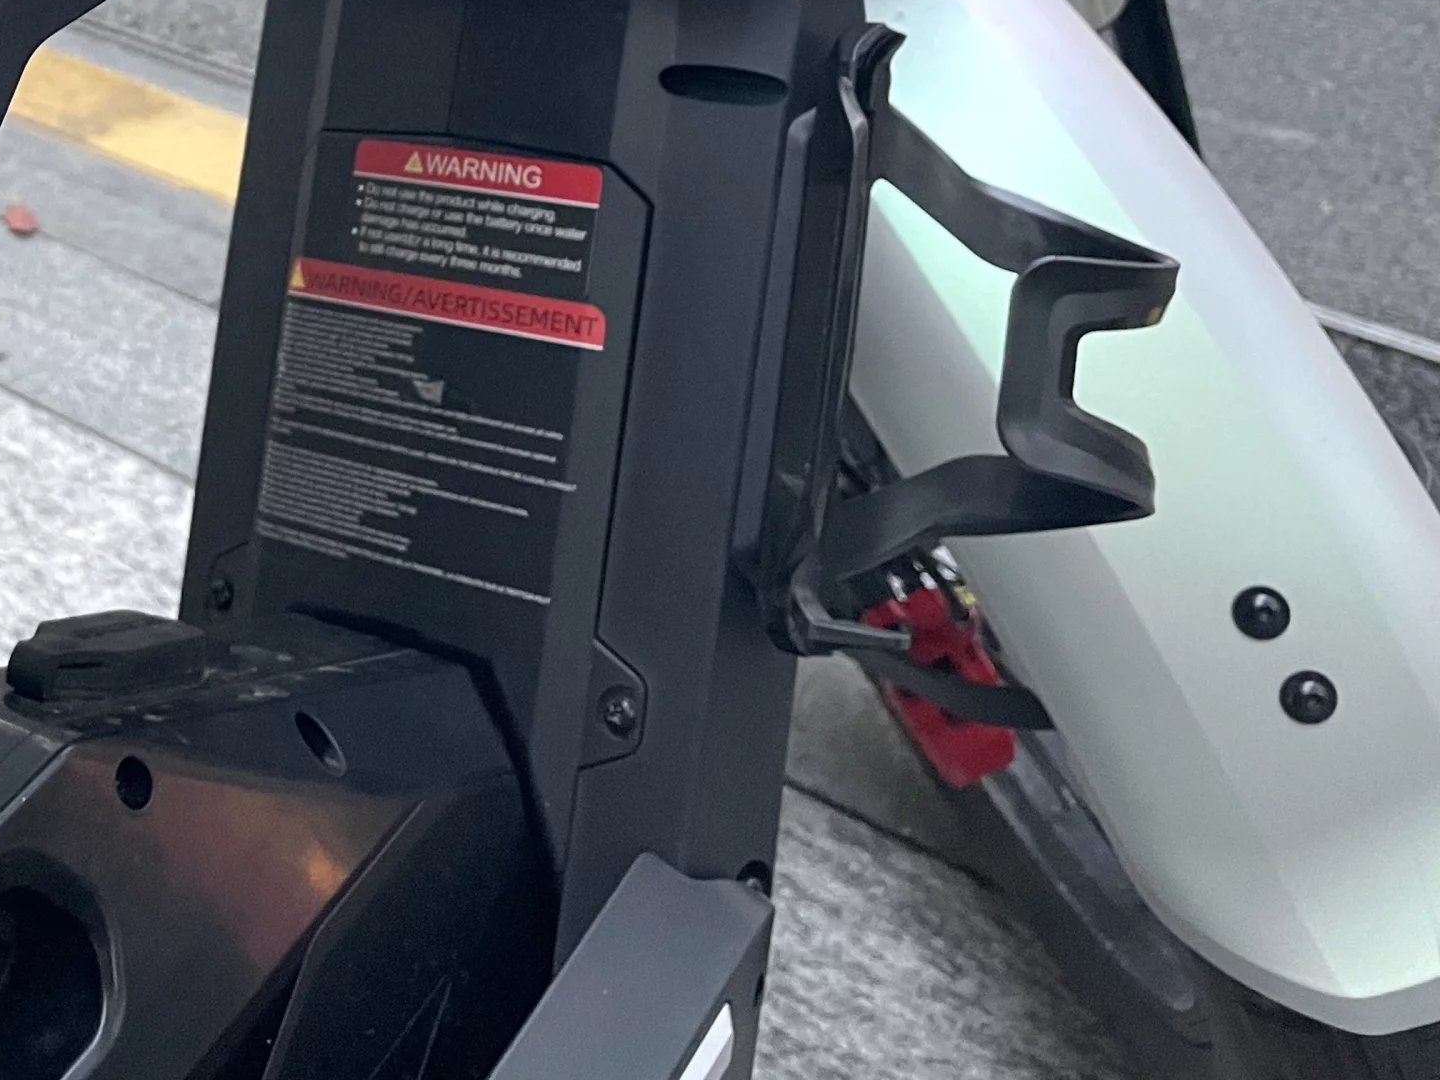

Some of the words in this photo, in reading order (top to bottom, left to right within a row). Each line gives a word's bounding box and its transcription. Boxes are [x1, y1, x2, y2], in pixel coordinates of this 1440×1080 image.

[426, 151, 543, 189] WARNING
[366, 182, 380, 196] Do
[381, 186, 398, 198] not
[398, 190, 417, 202] use
[418, 191, 434, 203] the
[435, 194, 476, 210] product
[477, 199, 505, 213] while
[361, 212, 400, 229] damage
[401, 217, 419, 231] has
[364, 196, 378, 209] Do
[380, 200, 396, 211] not
[397, 203, 430, 218] charge
[431, 209, 443, 219] or
[444, 211, 465, 223] use
[465, 211, 484, 225] the
[485, 215, 523, 234] battery
[524, 222, 553, 237] once
[554, 226, 588, 241] water
[367, 228, 383, 239] not
[431, 236, 454, 254] long
[482, 245, 490, 257] it
[491, 247, 501, 259] is
[501, 250, 582, 273] recommended
[385, 245, 419, 262] charge
[419, 252, 448, 267] every
[450, 254, 477, 271] three
[308, 271, 598, 337] WARNING/AVERTISSEMENT
